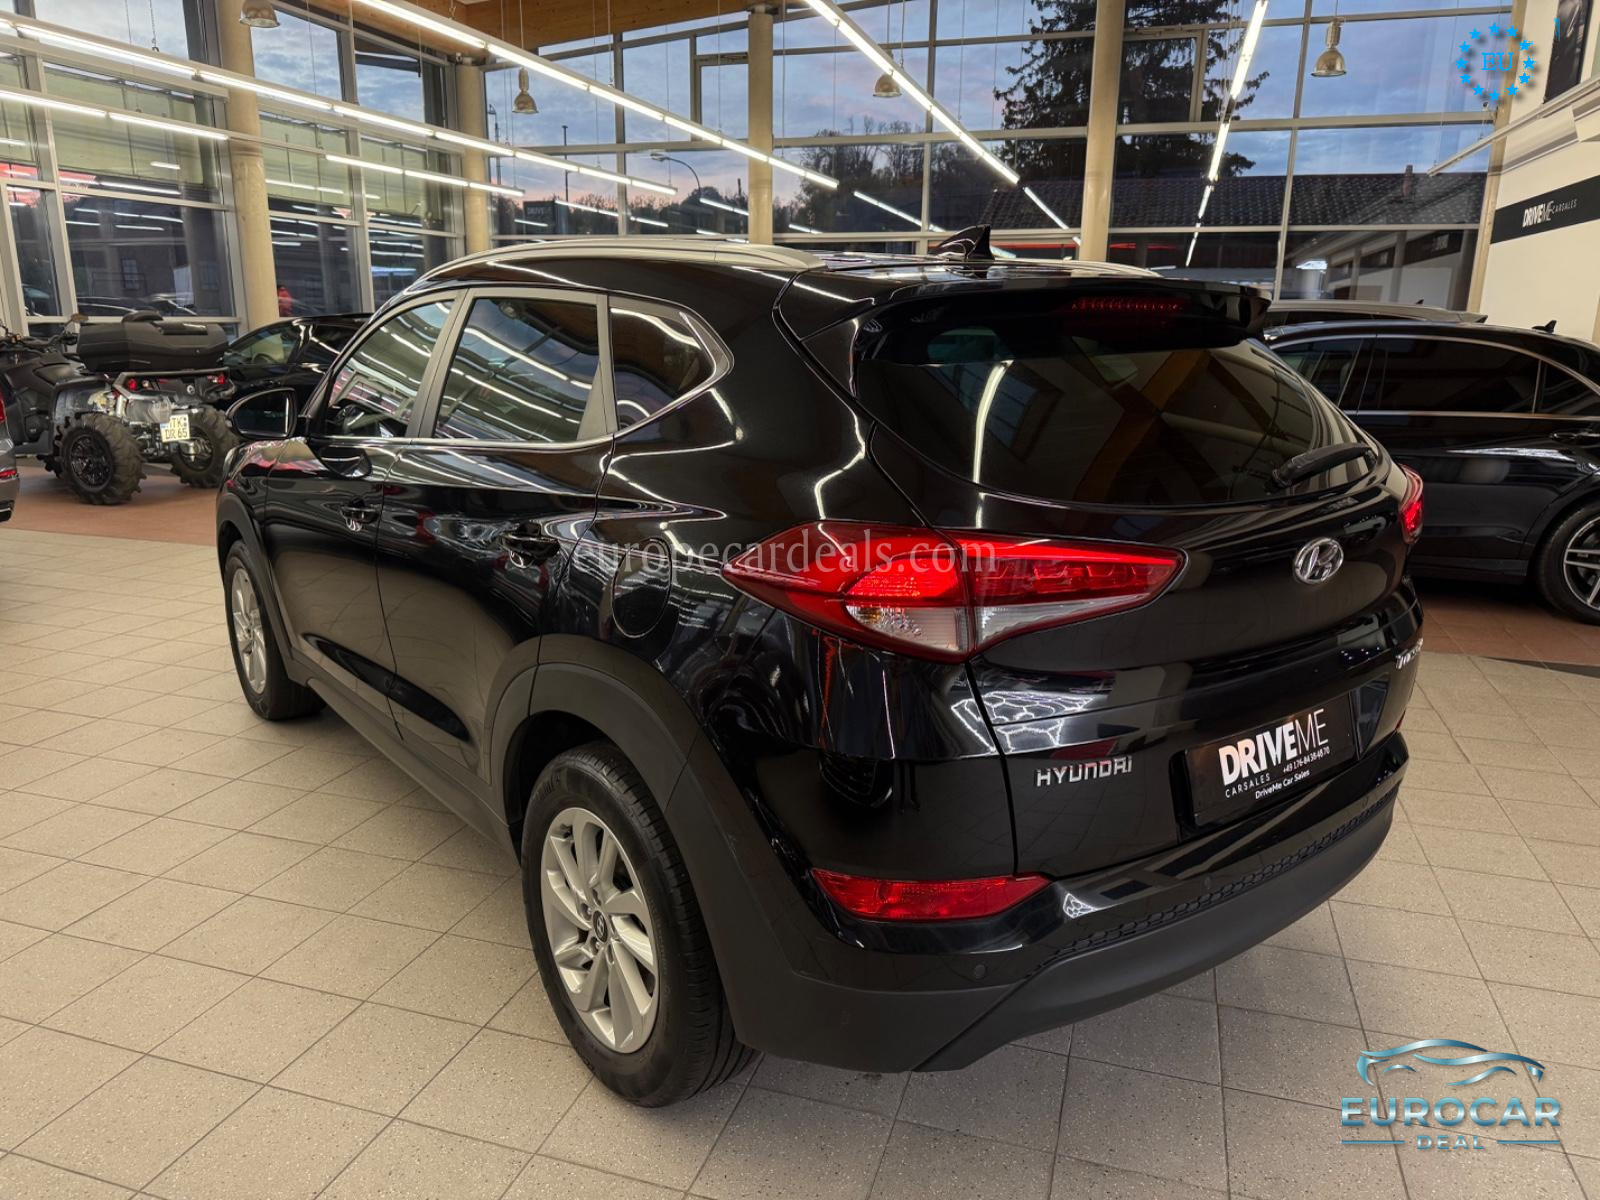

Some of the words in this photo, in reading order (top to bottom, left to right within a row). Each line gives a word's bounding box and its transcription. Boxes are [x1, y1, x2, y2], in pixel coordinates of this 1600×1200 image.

[1218, 708, 1329, 786] DRIVEME
[1036, 756, 1132, 787] HYUNDAI
[1225, 773, 1271, 799] CARSALES
[1255, 783, 1283, 800] DriveMe
[1282, 777, 1294, 787] Car
[1293, 769, 1310, 782] Sales
